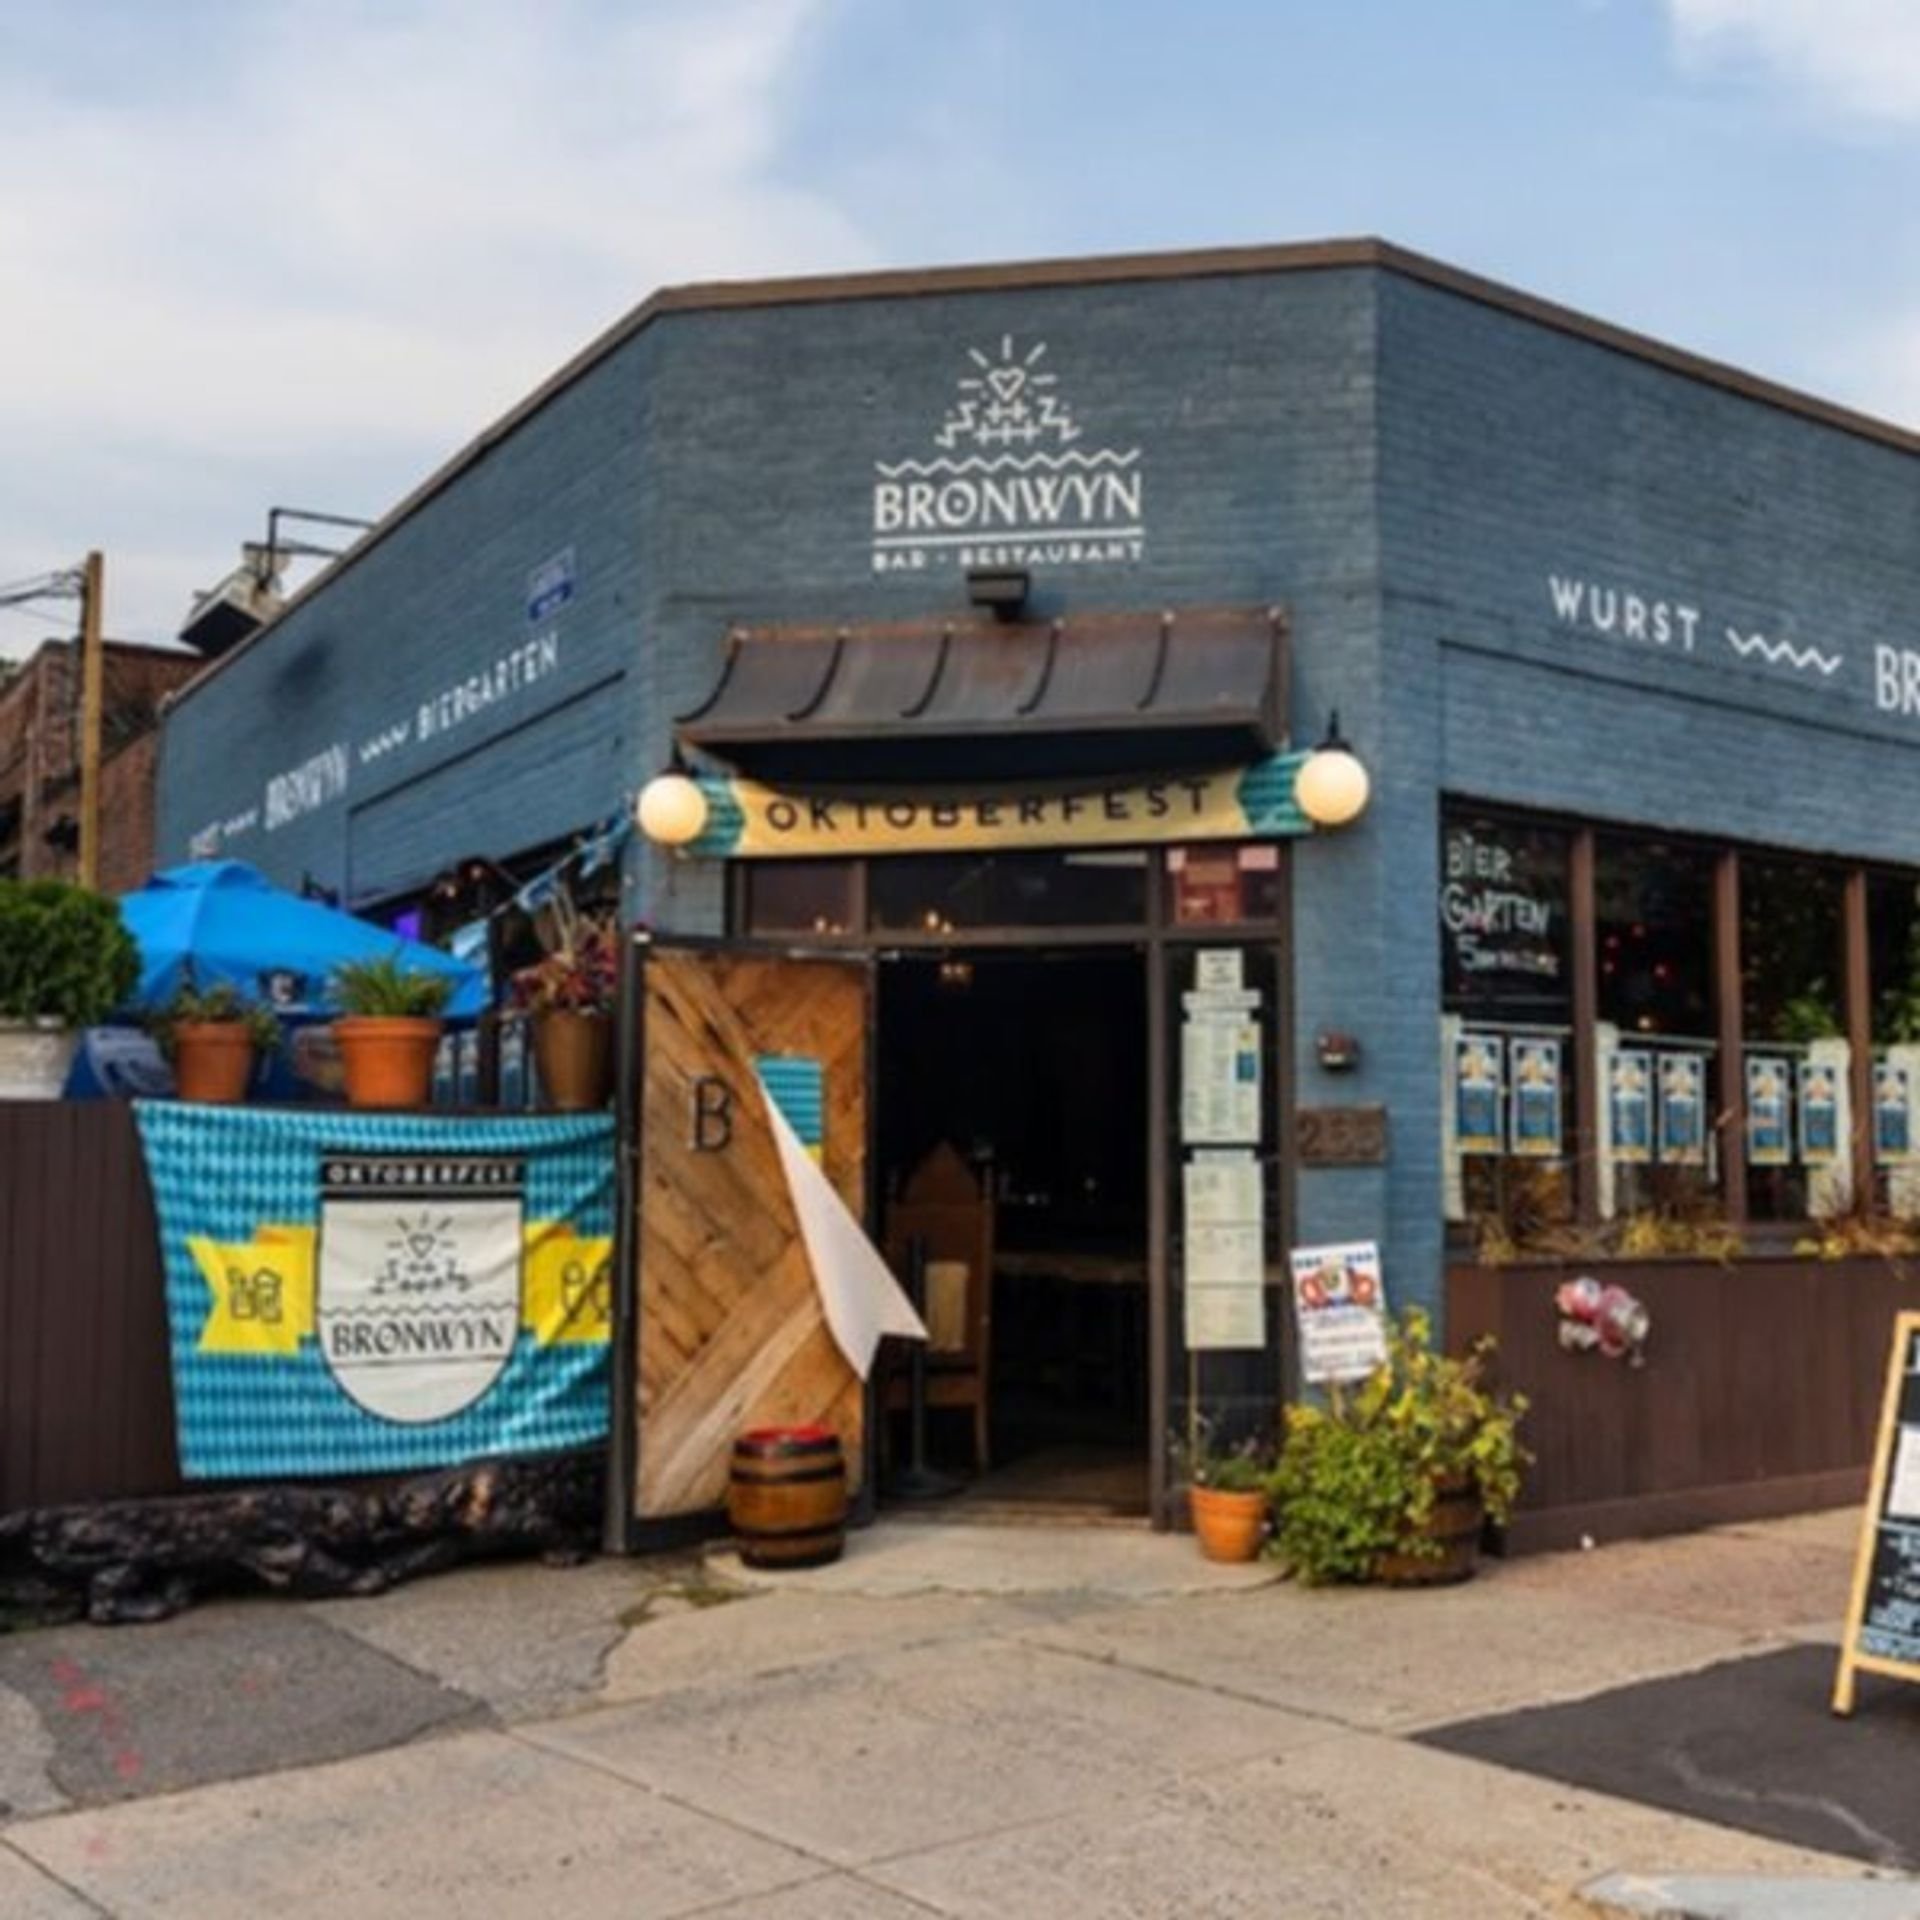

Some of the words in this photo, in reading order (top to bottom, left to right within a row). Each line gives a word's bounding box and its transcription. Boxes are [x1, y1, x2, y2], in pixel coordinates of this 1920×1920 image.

[873, 472, 1142, 531] BRONWYN
[873, 551, 924, 571] BAR
[959, 541, 1142, 567] RESTAURANT
[1548, 575, 1699, 651] WURST
[417, 631, 558, 742] BIERGARTEN
[765, 778, 1211, 832] OKTOBERFEST
[690, 1079, 732, 1152] B
[329, 1163, 519, 1185] OKTOBERFEST
[331, 1317, 504, 1356] BRONWYN
